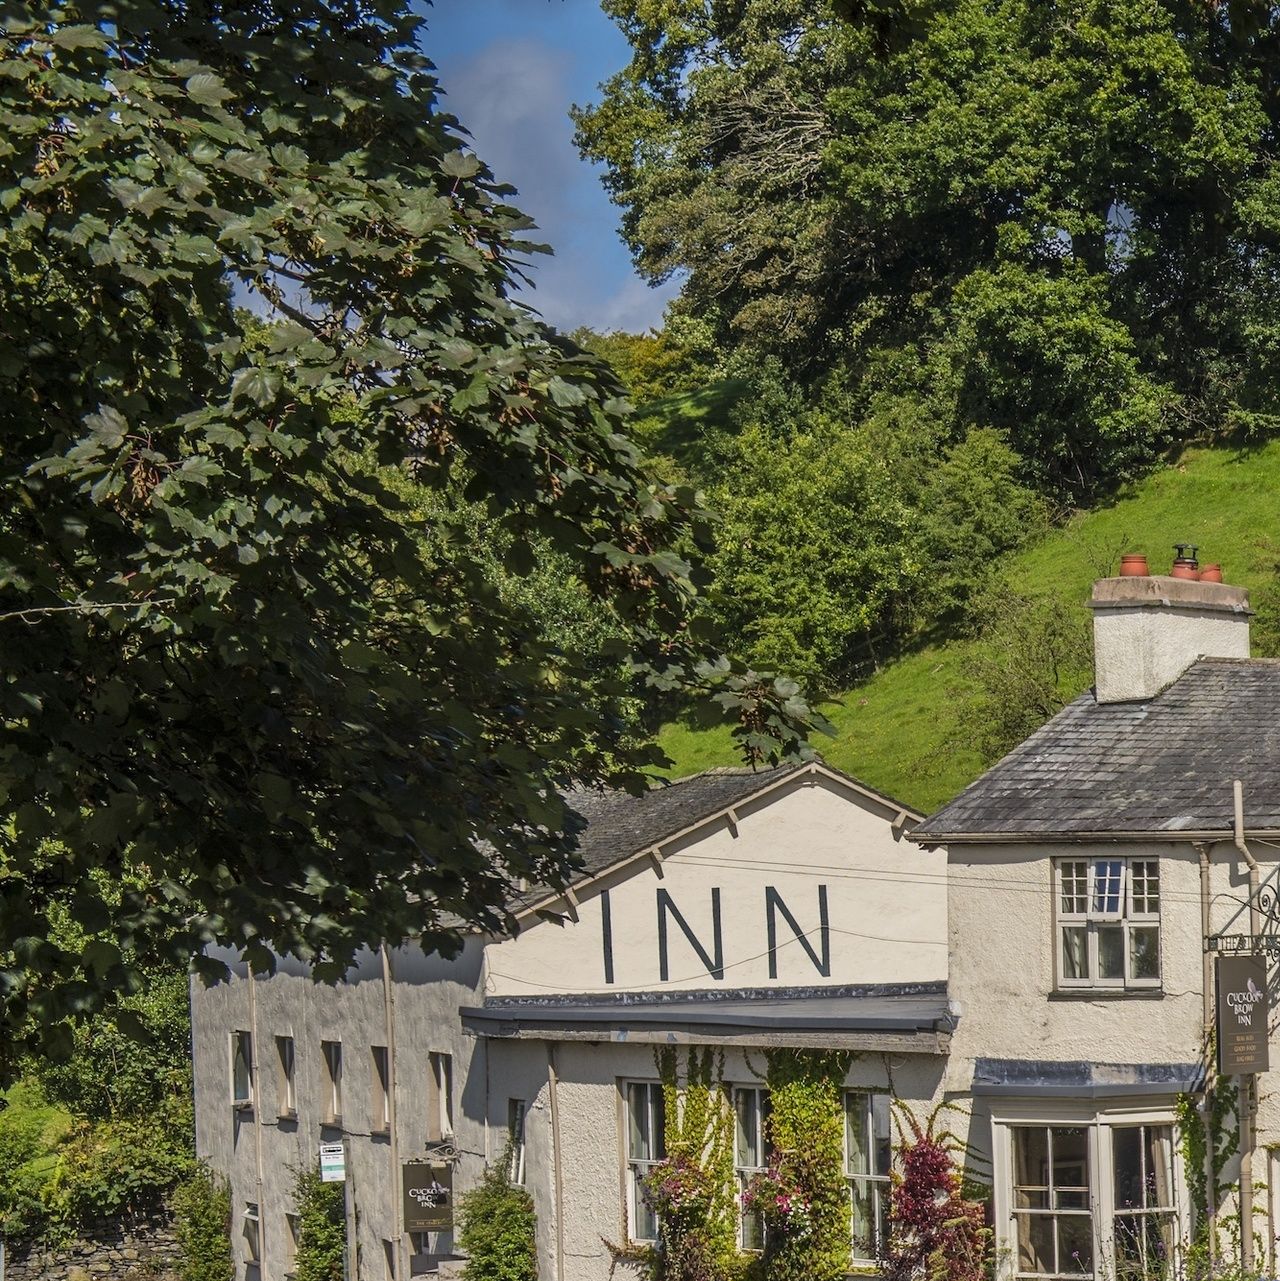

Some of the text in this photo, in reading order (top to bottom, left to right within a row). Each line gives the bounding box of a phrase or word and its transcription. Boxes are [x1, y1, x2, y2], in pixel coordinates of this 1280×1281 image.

[600, 884, 832, 984] INN
[1226, 992, 1259, 1007] CUCKOO
[1234, 1003, 1254, 1015] BROW
[1237, 1014, 1252, 1026] INN
